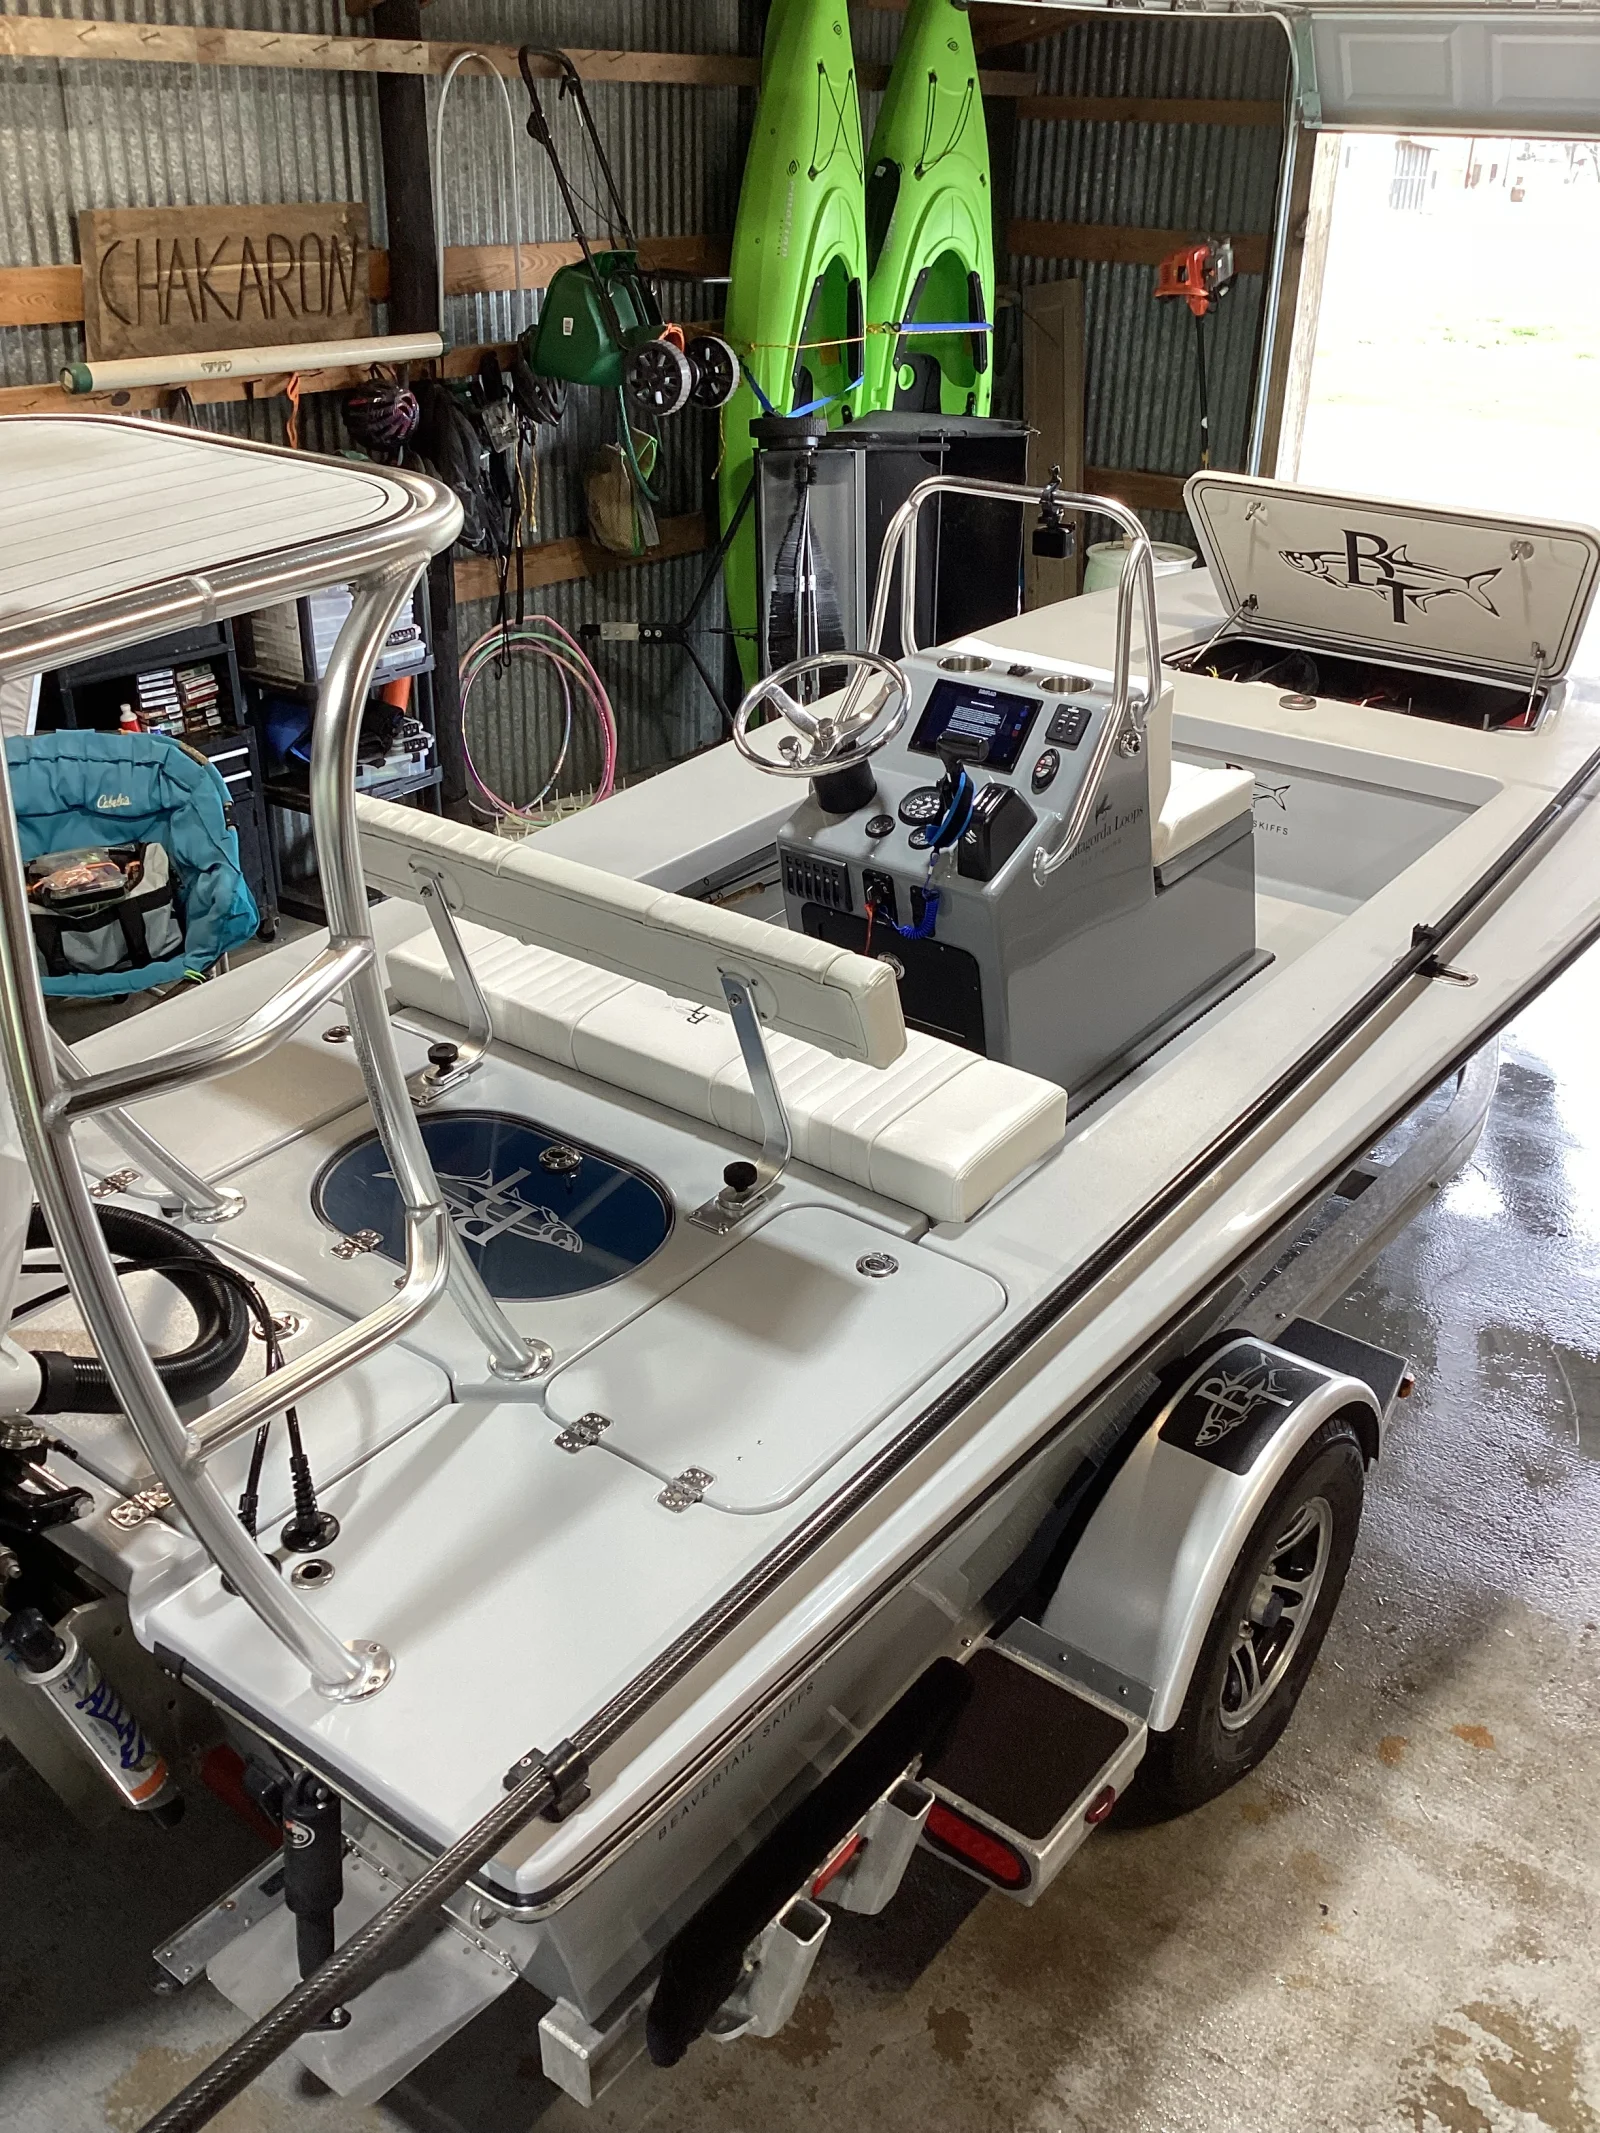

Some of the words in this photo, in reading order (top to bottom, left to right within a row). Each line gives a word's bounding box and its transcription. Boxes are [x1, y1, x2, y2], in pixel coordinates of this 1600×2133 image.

[99, 232, 359, 326] CHAKARON
[1114, 808, 1143, 831] Loops
[1253, 820, 1289, 836] SKIFFS
[658, 1743, 754, 1840] BEAVERTAIL
